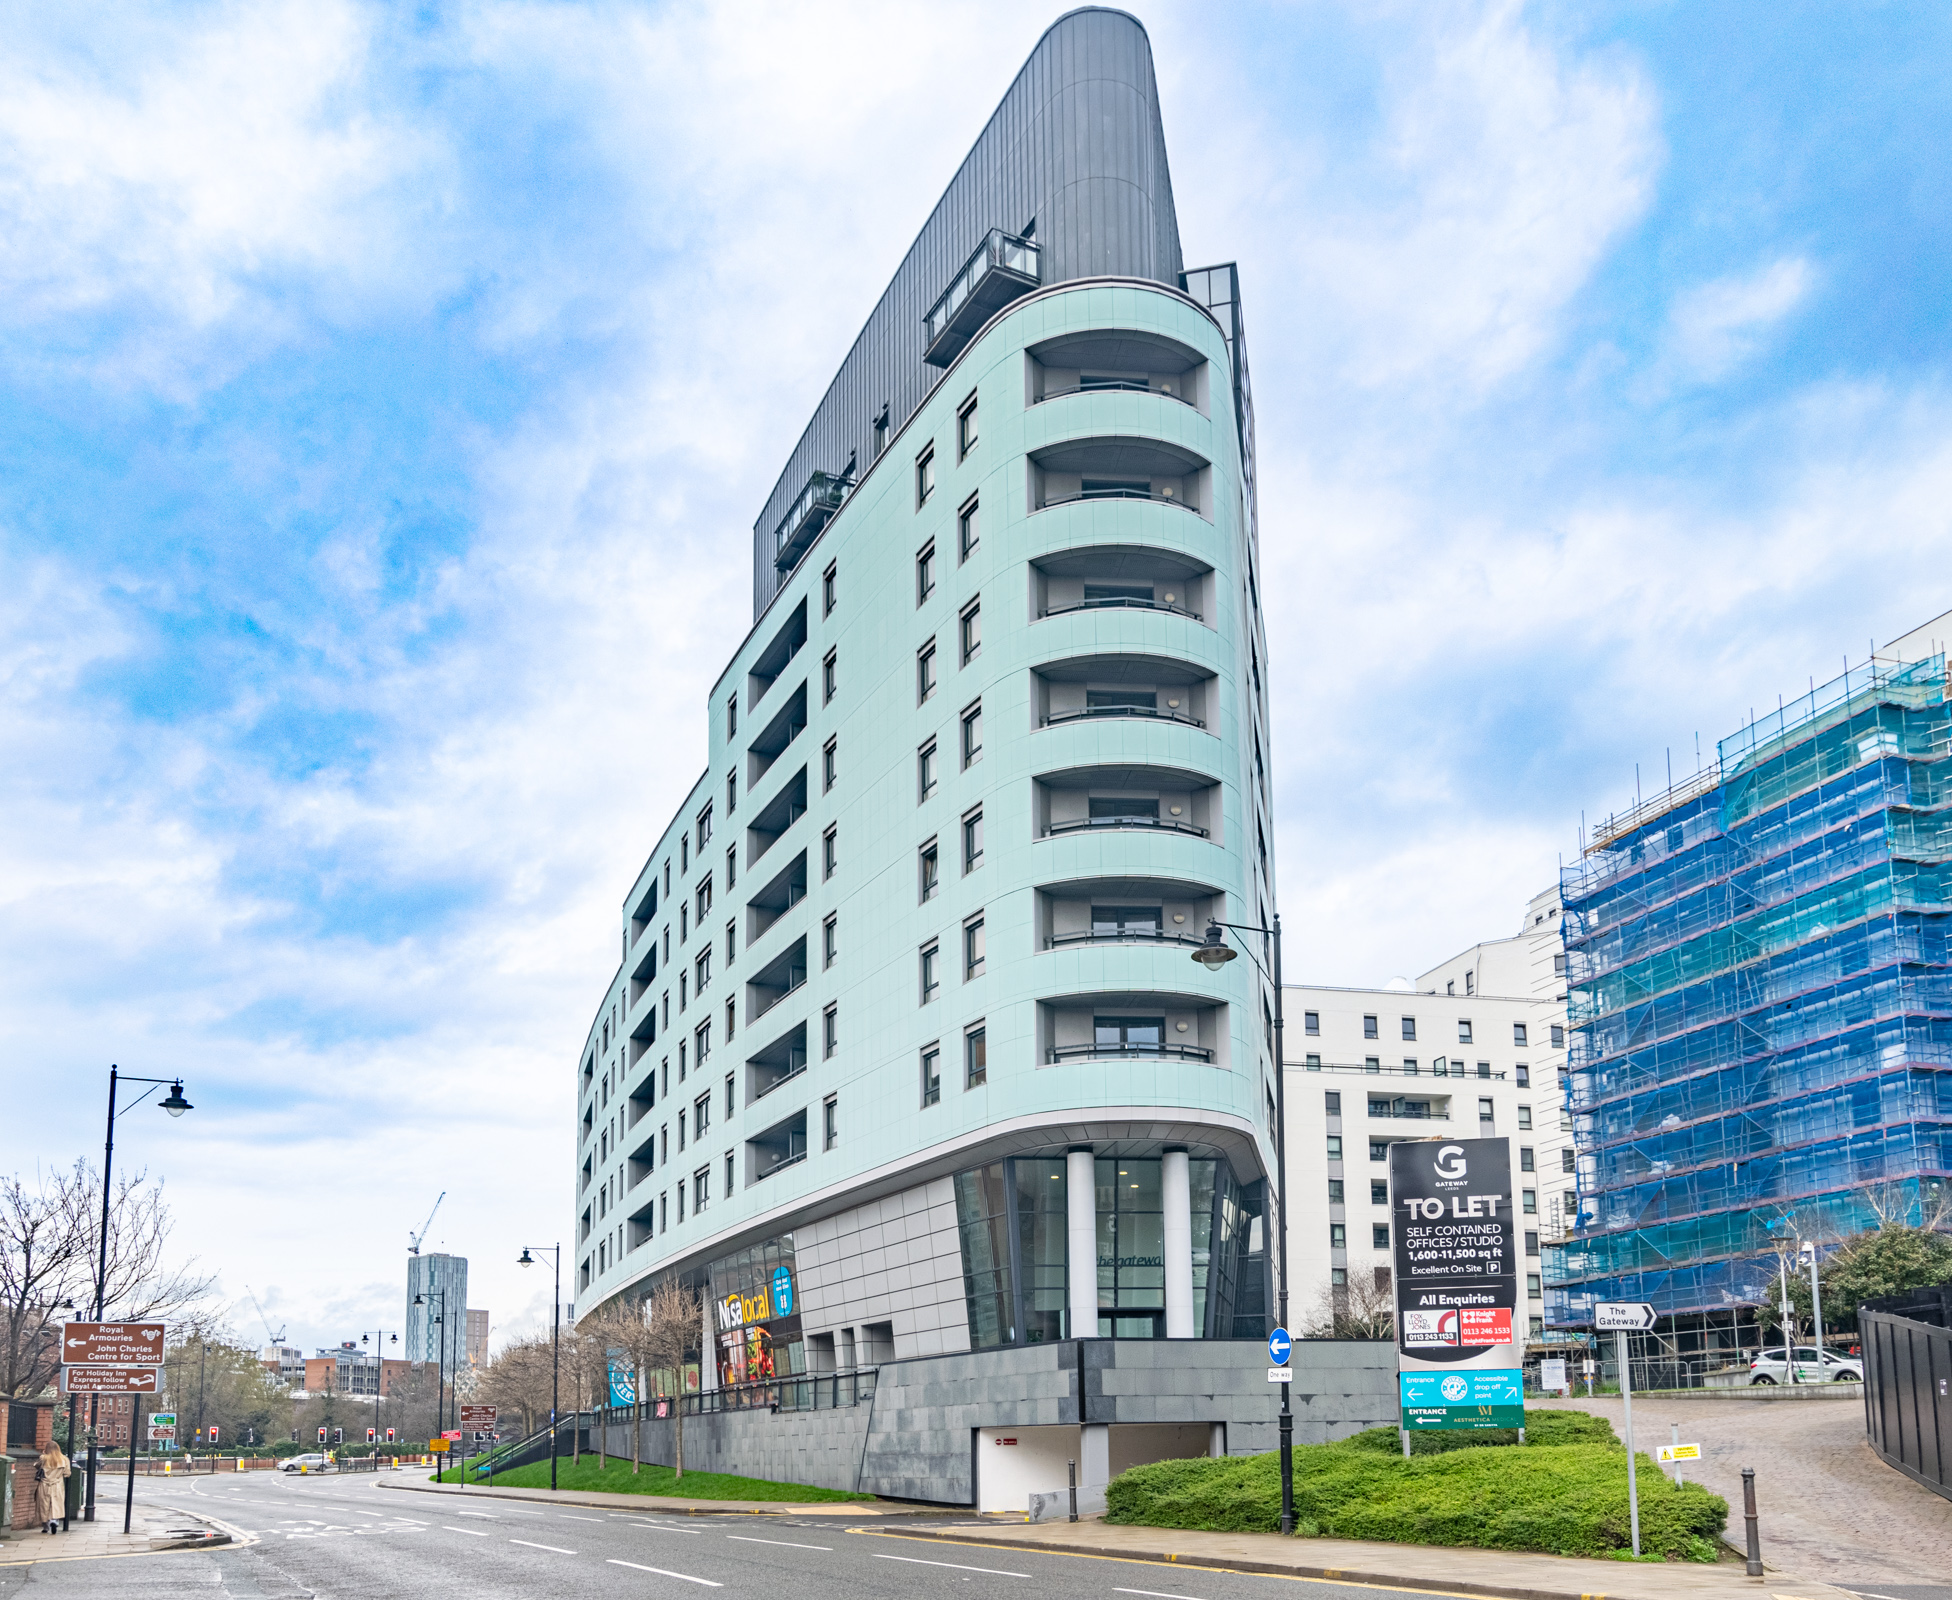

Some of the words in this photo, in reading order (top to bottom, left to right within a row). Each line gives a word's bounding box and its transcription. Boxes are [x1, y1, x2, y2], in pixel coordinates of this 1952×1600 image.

[1434, 1145, 1467, 1179] G
[1404, 1198, 1444, 1220] TO
[1452, 1194, 1502, 1218] LET
[1406, 1226, 1432, 1237] SELF
[1435, 1224, 1502, 1236] CONTAINED
[1478, 1250, 1491, 1259] sq
[1493, 1248, 1502, 1257] ft
[1118, 1256, 1161, 1269] gatewa
[1412, 1266, 1449, 1274] Excellent
[1451, 1265, 1464, 1273] On
[1465, 1264, 1482, 1272] Site
[1420, 1295, 1436, 1305] All
[1439, 1294, 1495, 1306] Enquiries
[1599, 1318, 1640, 1326] Gateway
[1447, 1382, 1462, 1395] GP
